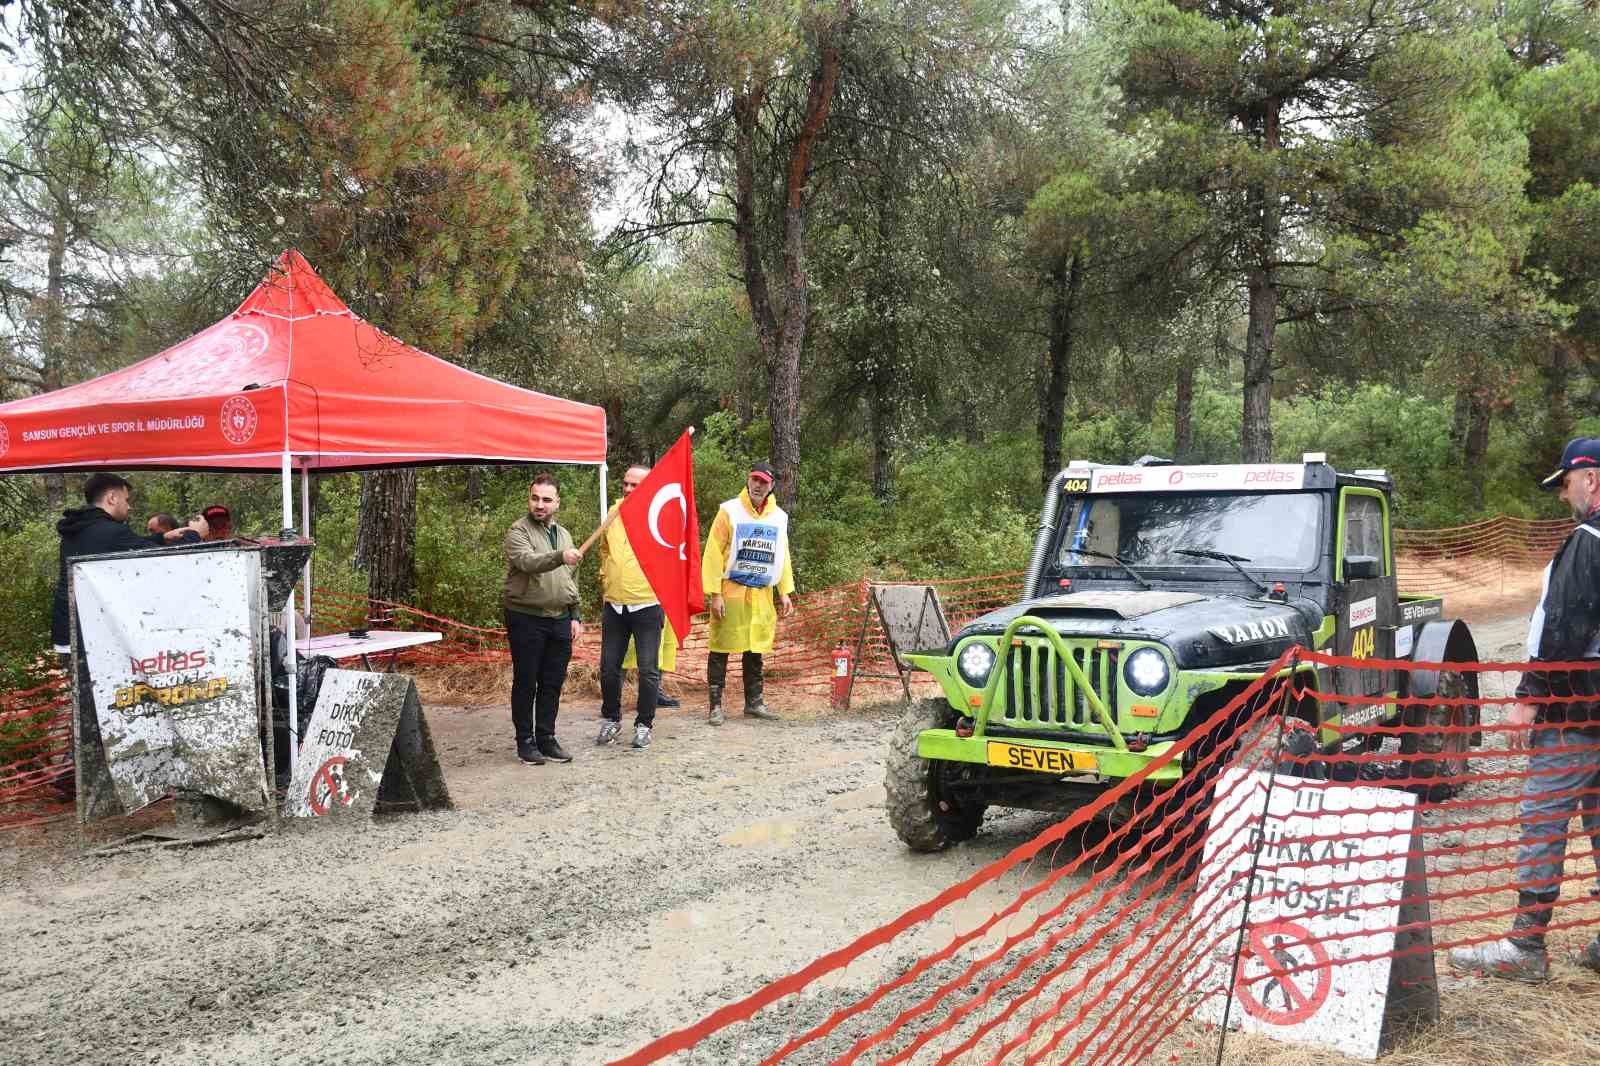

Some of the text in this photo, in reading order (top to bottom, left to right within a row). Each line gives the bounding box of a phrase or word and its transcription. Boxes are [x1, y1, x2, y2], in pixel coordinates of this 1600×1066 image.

[22, 428, 58, 441] SAMSUN
[59, 422, 97, 438] GENÇLİK
[98, 423, 109, 433] VE
[111, 422, 136, 433] SPOR
[146, 416, 205, 431] MÜDÜRLÜĞÜ
[1063, 479, 1088, 492] 404
[1097, 471, 1144, 488] petlas
[1243, 467, 1296, 484] petlas
[1351, 626, 1376, 660] 404
[1008, 747, 1074, 771] SEVEN
